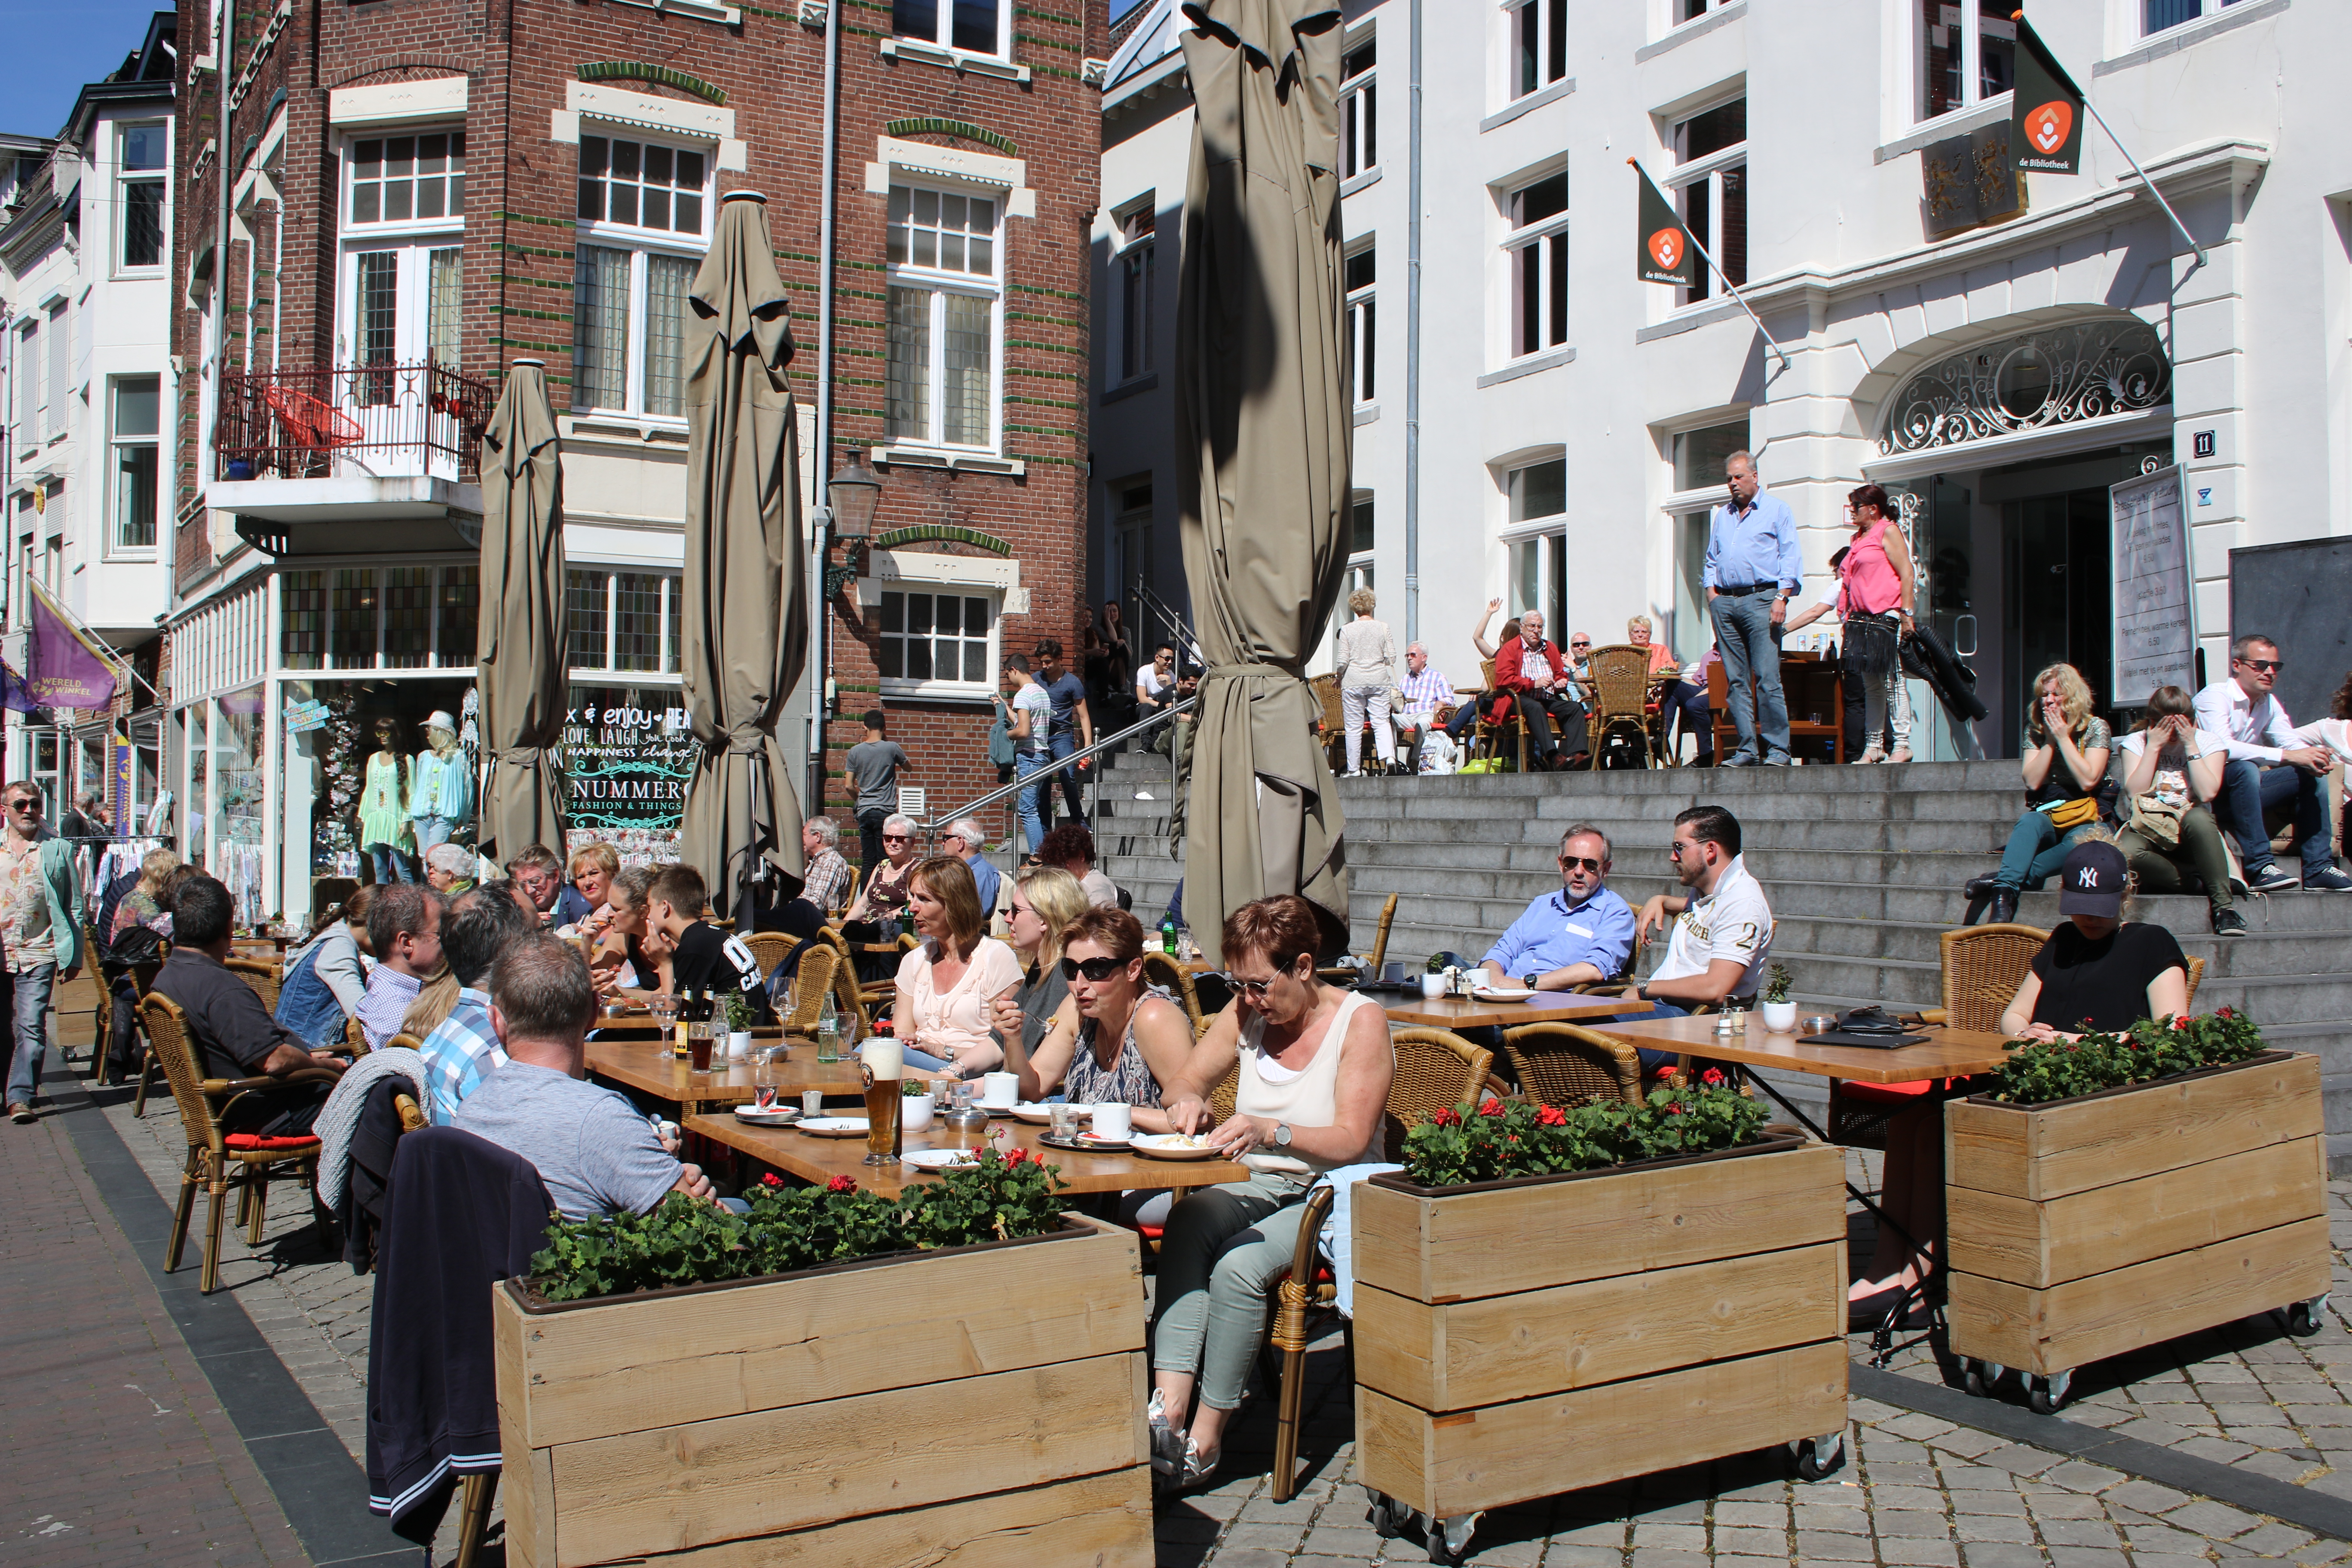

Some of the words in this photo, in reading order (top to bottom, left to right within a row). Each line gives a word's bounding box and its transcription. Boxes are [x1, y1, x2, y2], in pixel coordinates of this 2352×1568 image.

[2019, 157, 2028, 167] de
[2029, 158, 2069, 169] Bibliotheek
[1645, 270, 1654, 279] de
[1654, 272, 1687, 283] Bibliotheek
[2199, 435, 2210, 453] 11
[2115, 497, 2140, 513] Brasserie
[2148, 637, 2159, 646] 6.50
[2124, 668, 2137, 678] Wafel
[2139, 667, 2149, 675] met
[42, 677, 81, 687] WERELD
[2152, 680, 2162, 689] 5.25
[55, 686, 91, 695] WINKEL
[603, 703, 652, 729] enjoy
[563, 727, 593, 746] LOVE,
[600, 728, 638, 745] LAUGH
[639, 733, 664, 745] you
[567, 748, 636, 757] HAPPINESS
[642, 744, 692, 766] change
[573, 801, 622, 809] FASHION
[639, 802, 681, 810] THINGS
[621, 853, 652, 865] EITHER
[2078, 867, 2098, 888] NY
[1736, 922, 1757, 949] 2
